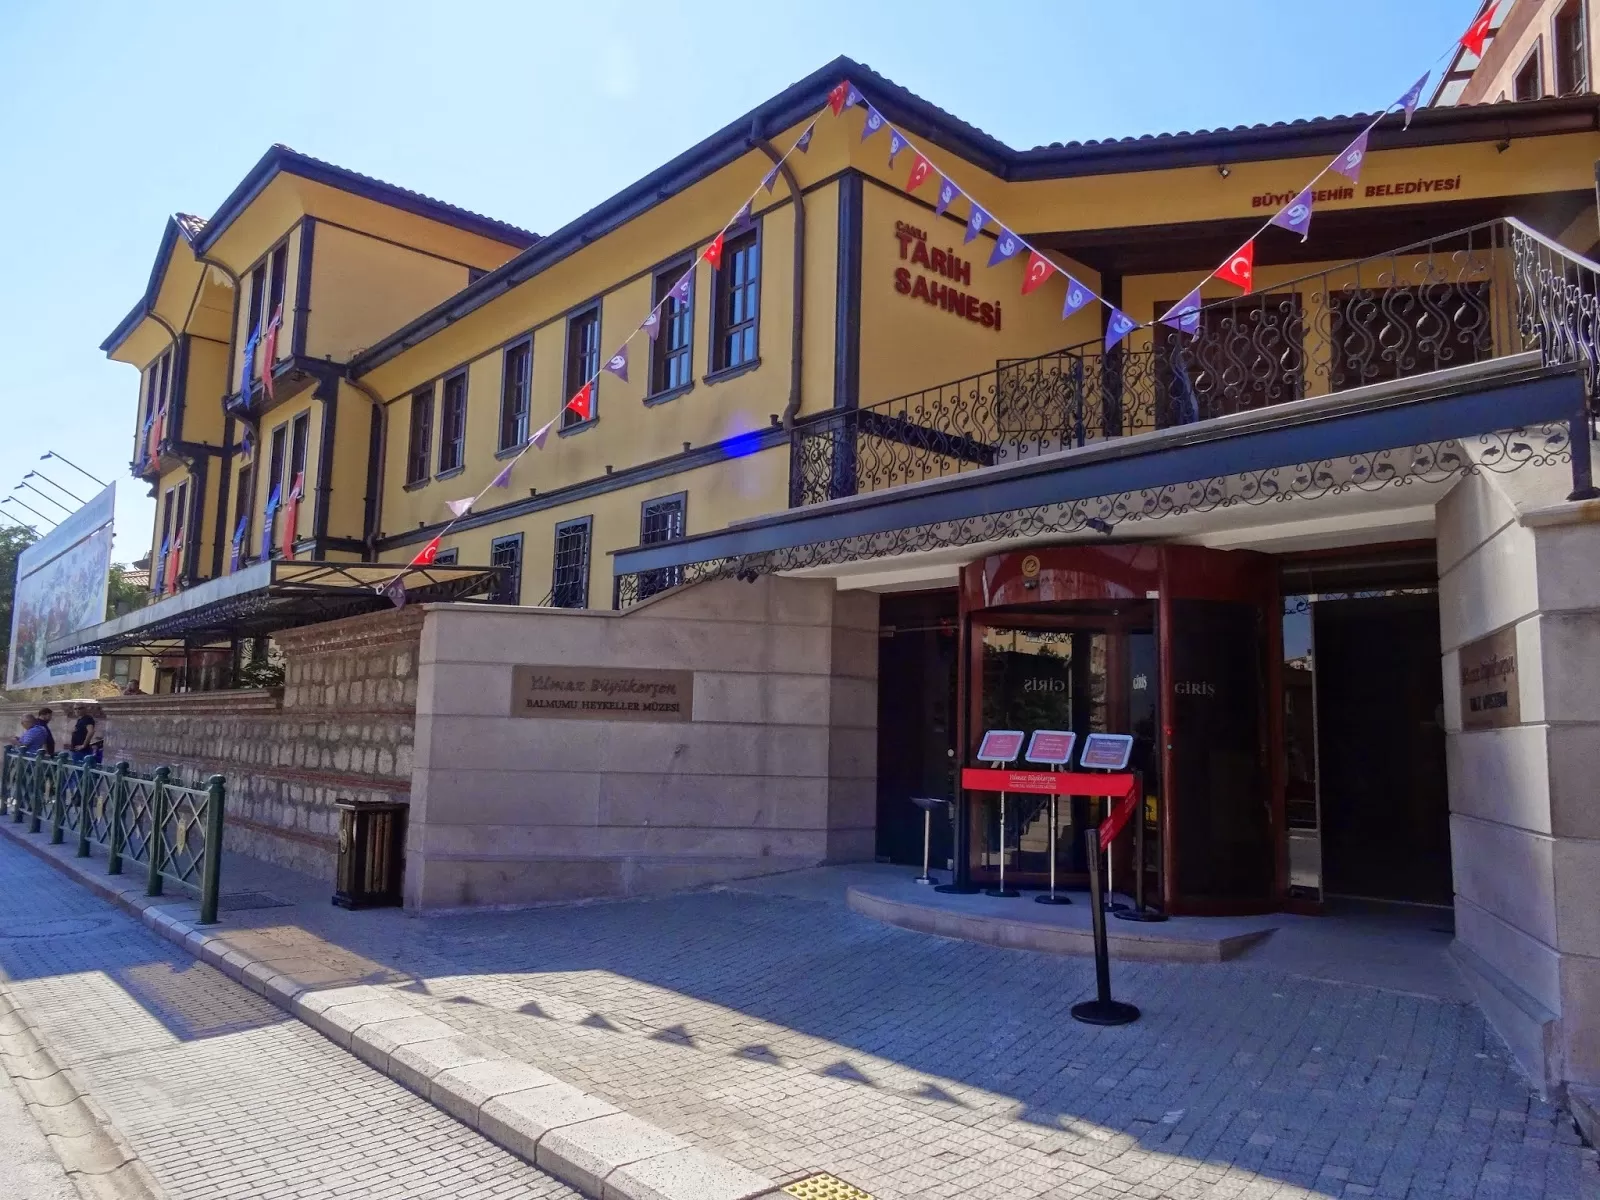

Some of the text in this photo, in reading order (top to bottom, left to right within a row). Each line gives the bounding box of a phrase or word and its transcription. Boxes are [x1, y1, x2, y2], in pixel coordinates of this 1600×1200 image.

[1252, 175, 1461, 207] BÜYÜŞEHİR BELEDİYESİ
[896, 231, 971, 286] TARİH
[895, 267, 1002, 331] SAHNESİ
[526, 699, 680, 713] BALMUMU HEYKELLER MÜZESİ
